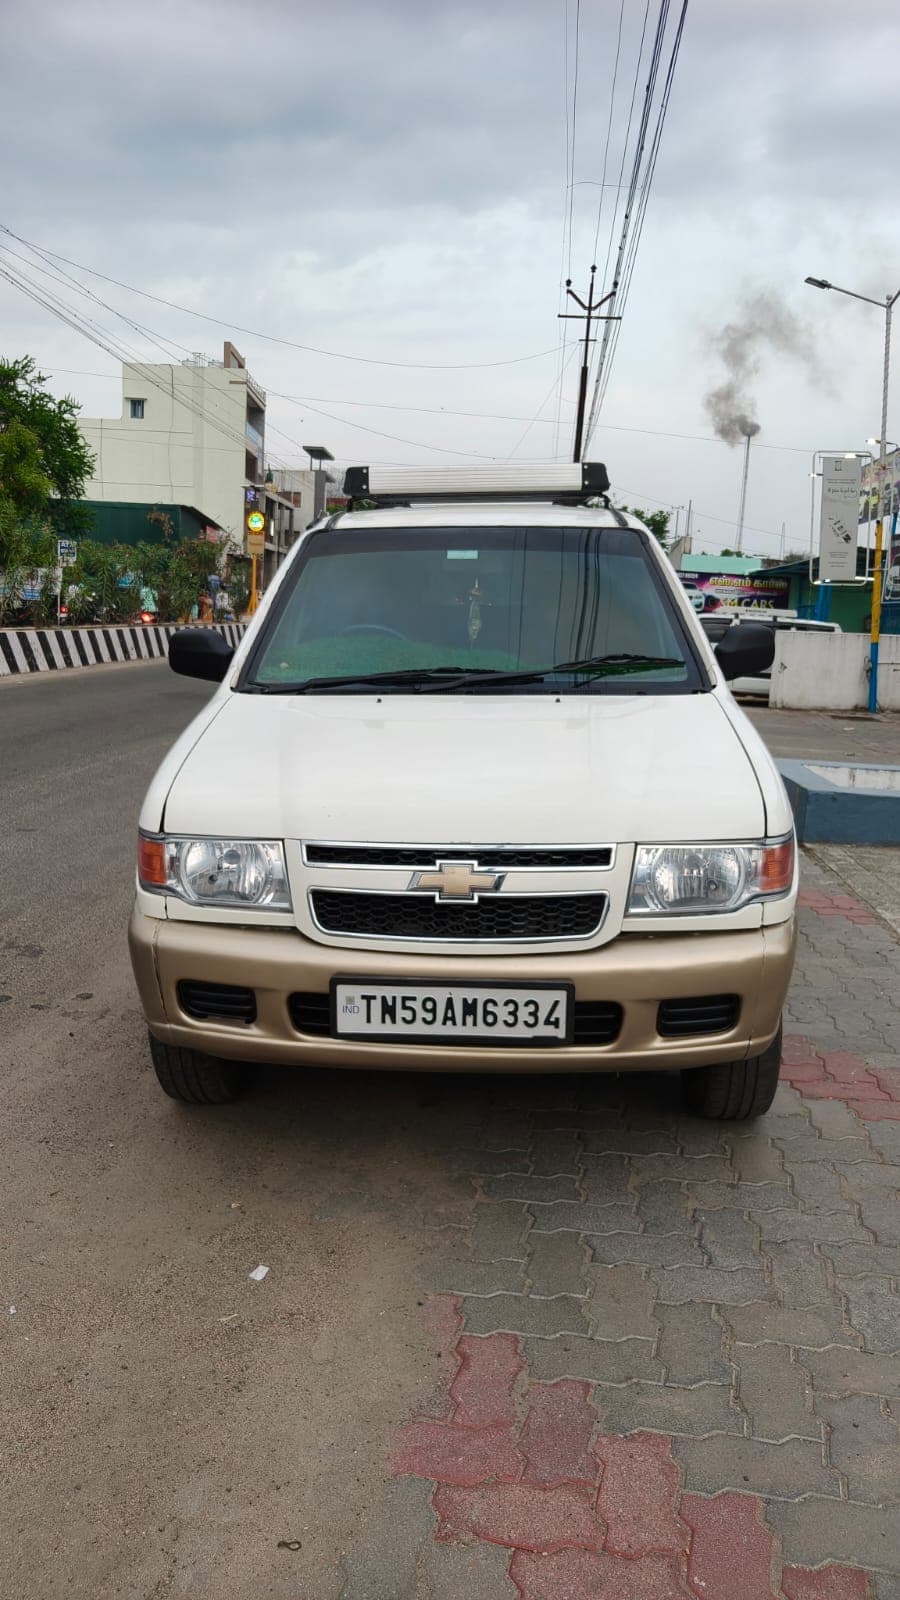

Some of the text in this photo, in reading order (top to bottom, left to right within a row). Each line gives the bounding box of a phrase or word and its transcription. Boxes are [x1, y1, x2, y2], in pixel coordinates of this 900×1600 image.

[741, 599, 774, 609] CARS
[342, 994, 561, 1029] IND TN59AM6334
